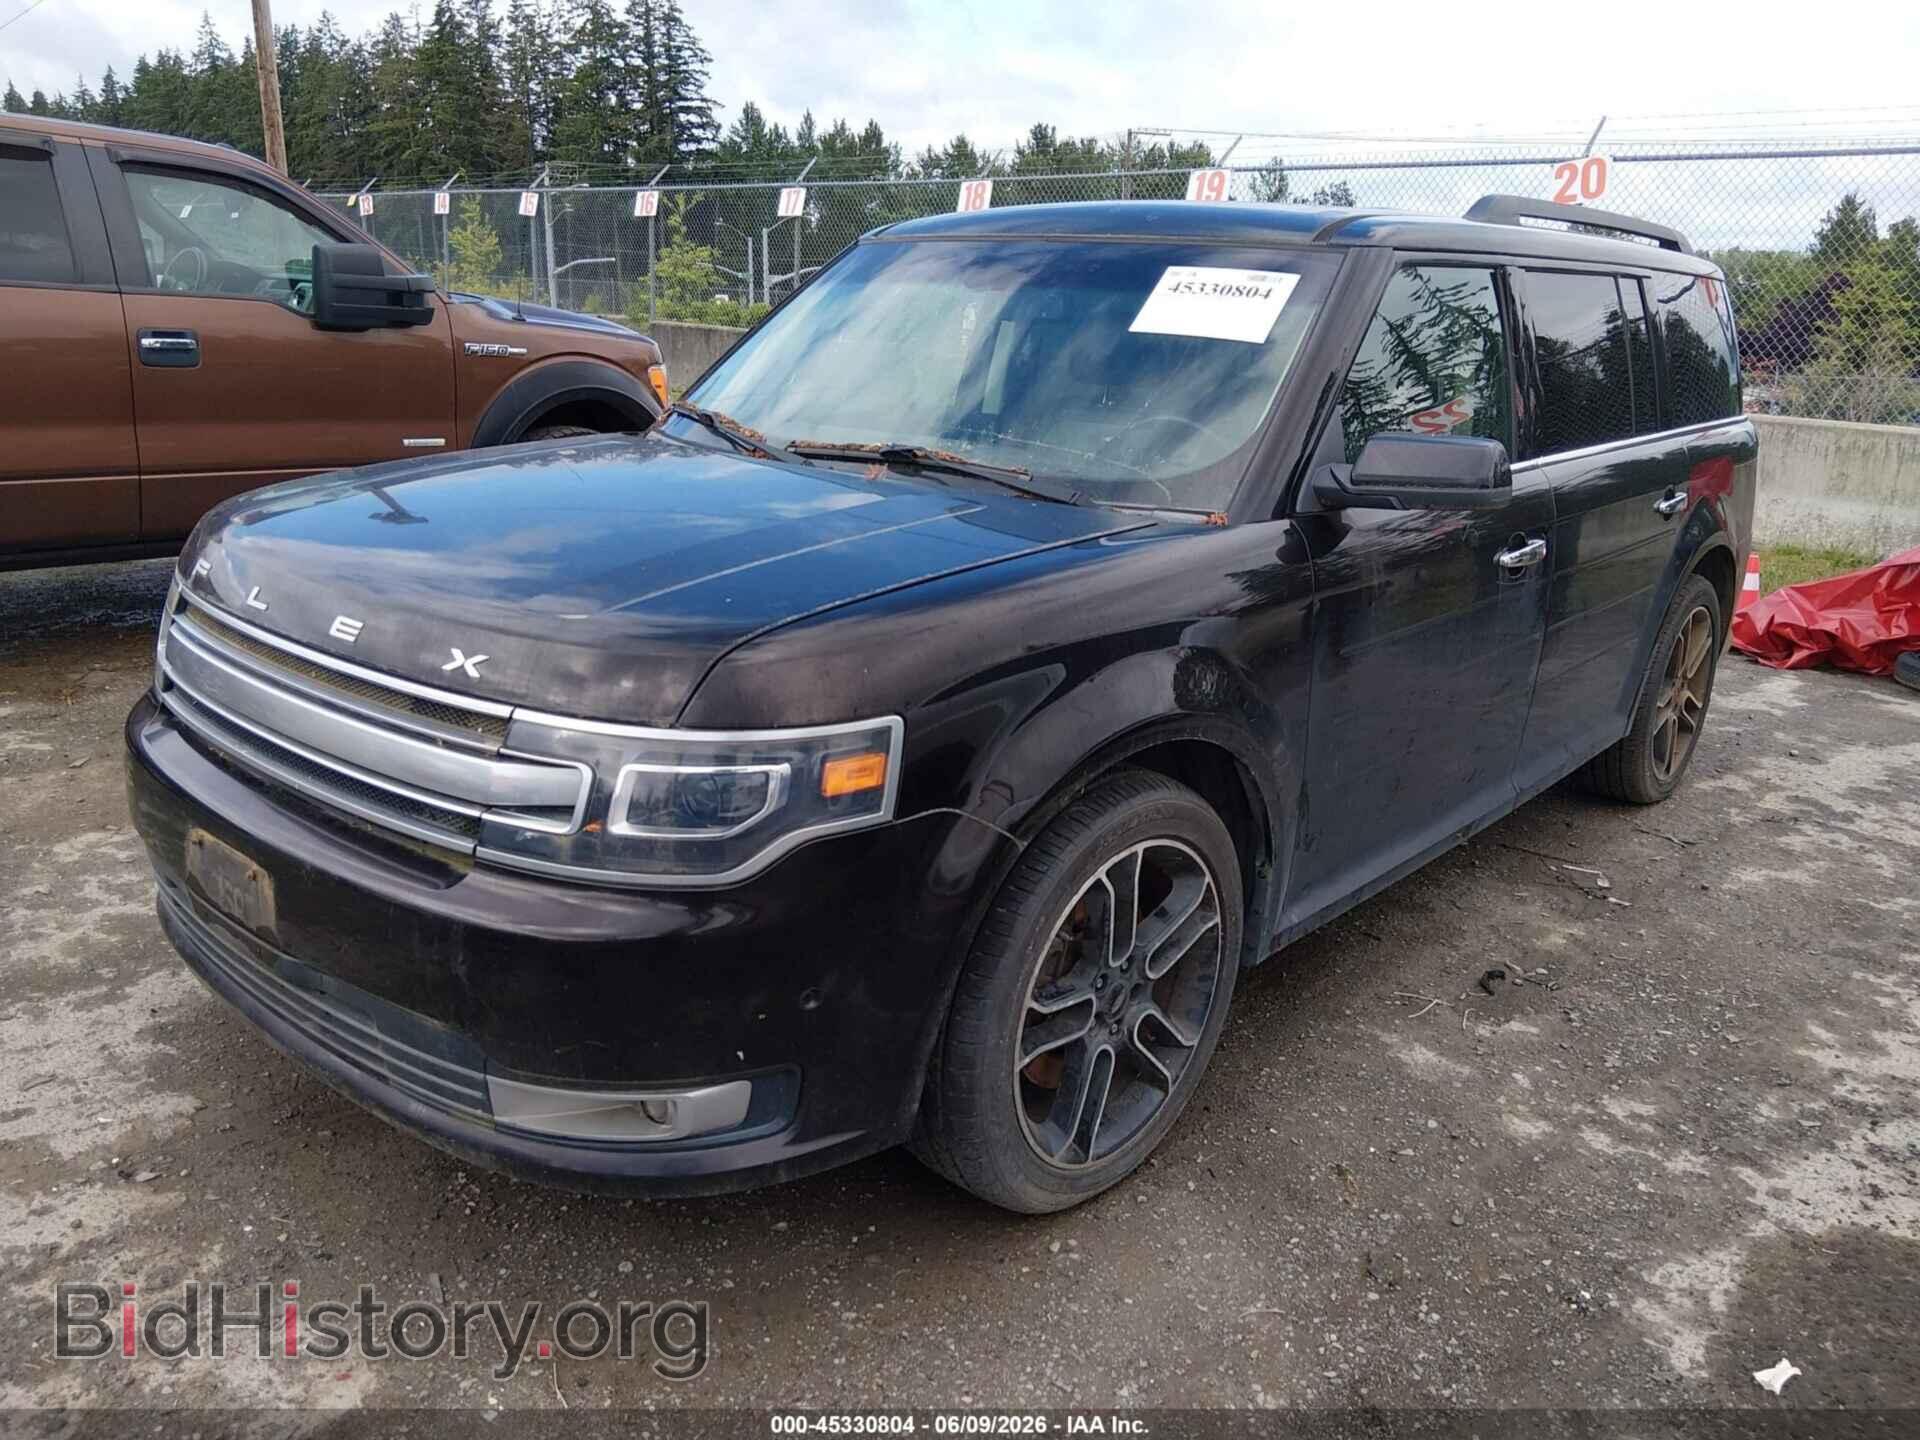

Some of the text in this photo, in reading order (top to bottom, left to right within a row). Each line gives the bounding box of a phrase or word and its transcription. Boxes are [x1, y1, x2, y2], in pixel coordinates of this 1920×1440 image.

[1196, 171, 1225, 201] 19
[1553, 158, 1607, 204] 20
[361, 195, 372, 214] 13
[436, 194, 448, 212] 14
[523, 193, 536, 214] 15
[640, 192, 655, 215] 16
[785, 189, 801, 215] 17
[964, 182, 986, 211] 18
[1167, 281, 1273, 299] 45330804
[188, 557, 490, 679] FLEX
